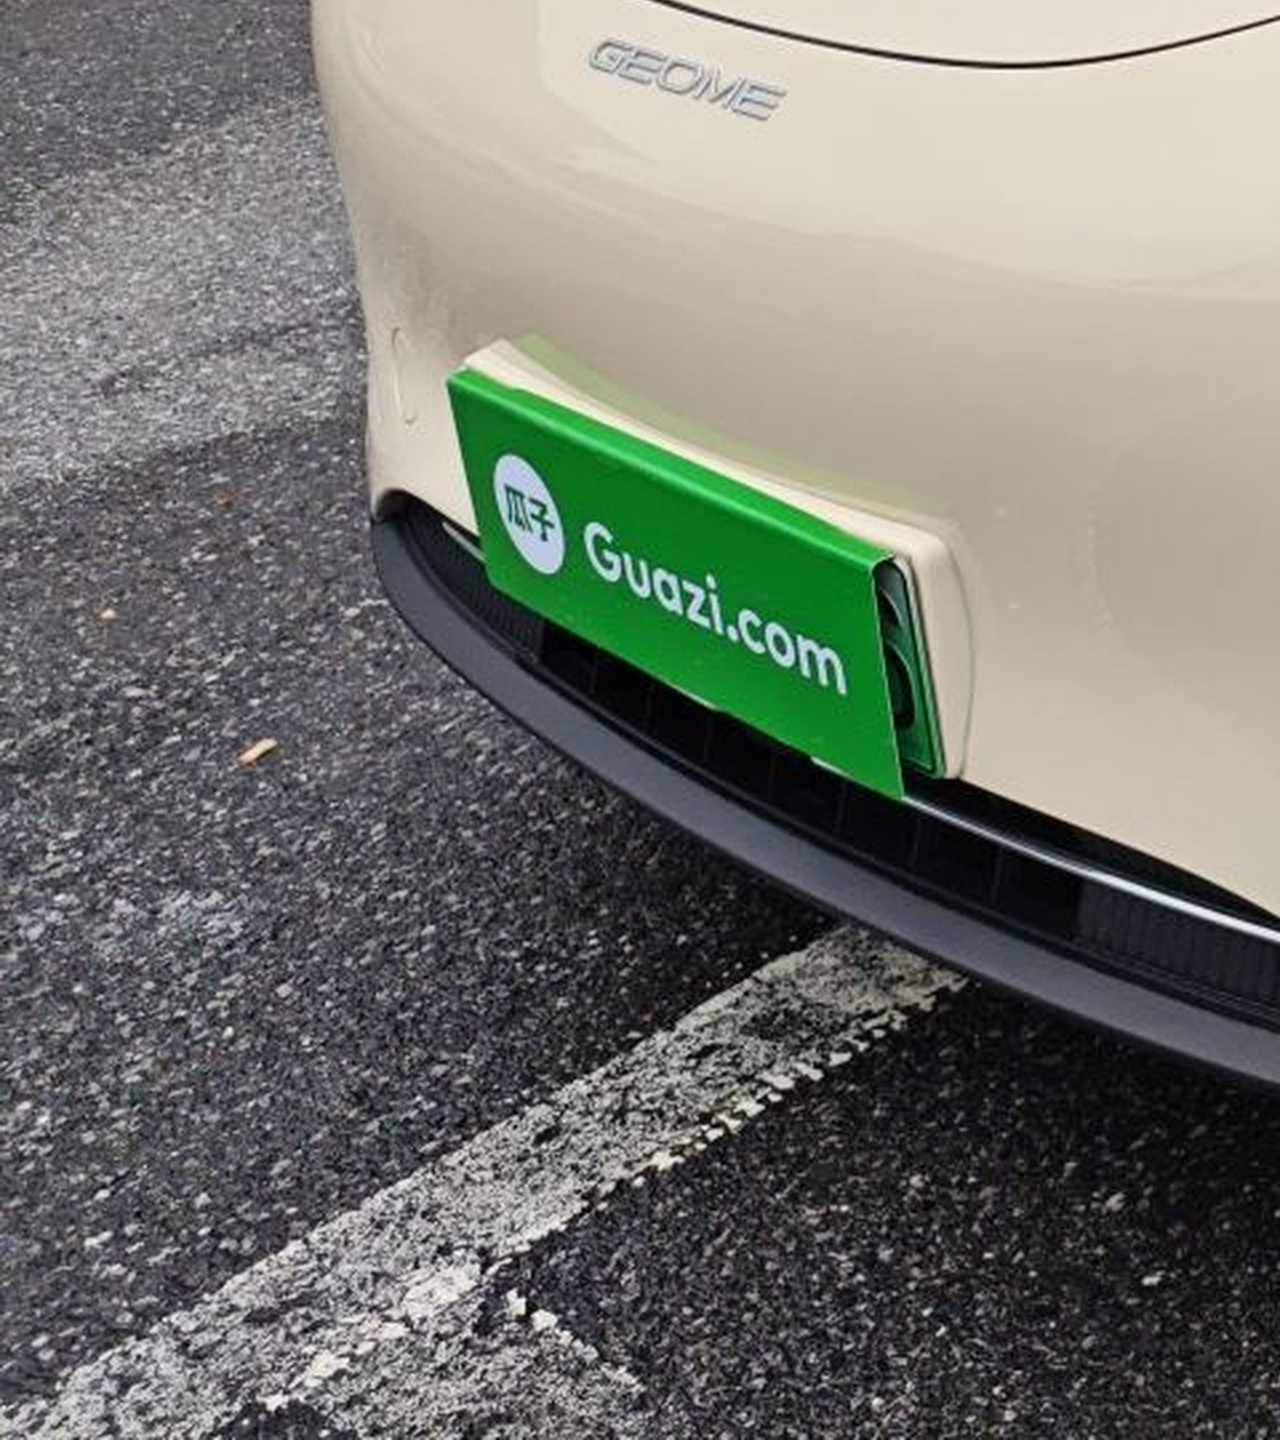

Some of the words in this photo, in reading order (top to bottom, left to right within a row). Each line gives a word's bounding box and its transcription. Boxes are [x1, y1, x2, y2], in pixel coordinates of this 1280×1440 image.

[589, 41, 787, 121] GEOME
[504, 483, 555, 543] 瓜子
[584, 521, 847, 695] Guazi.com
